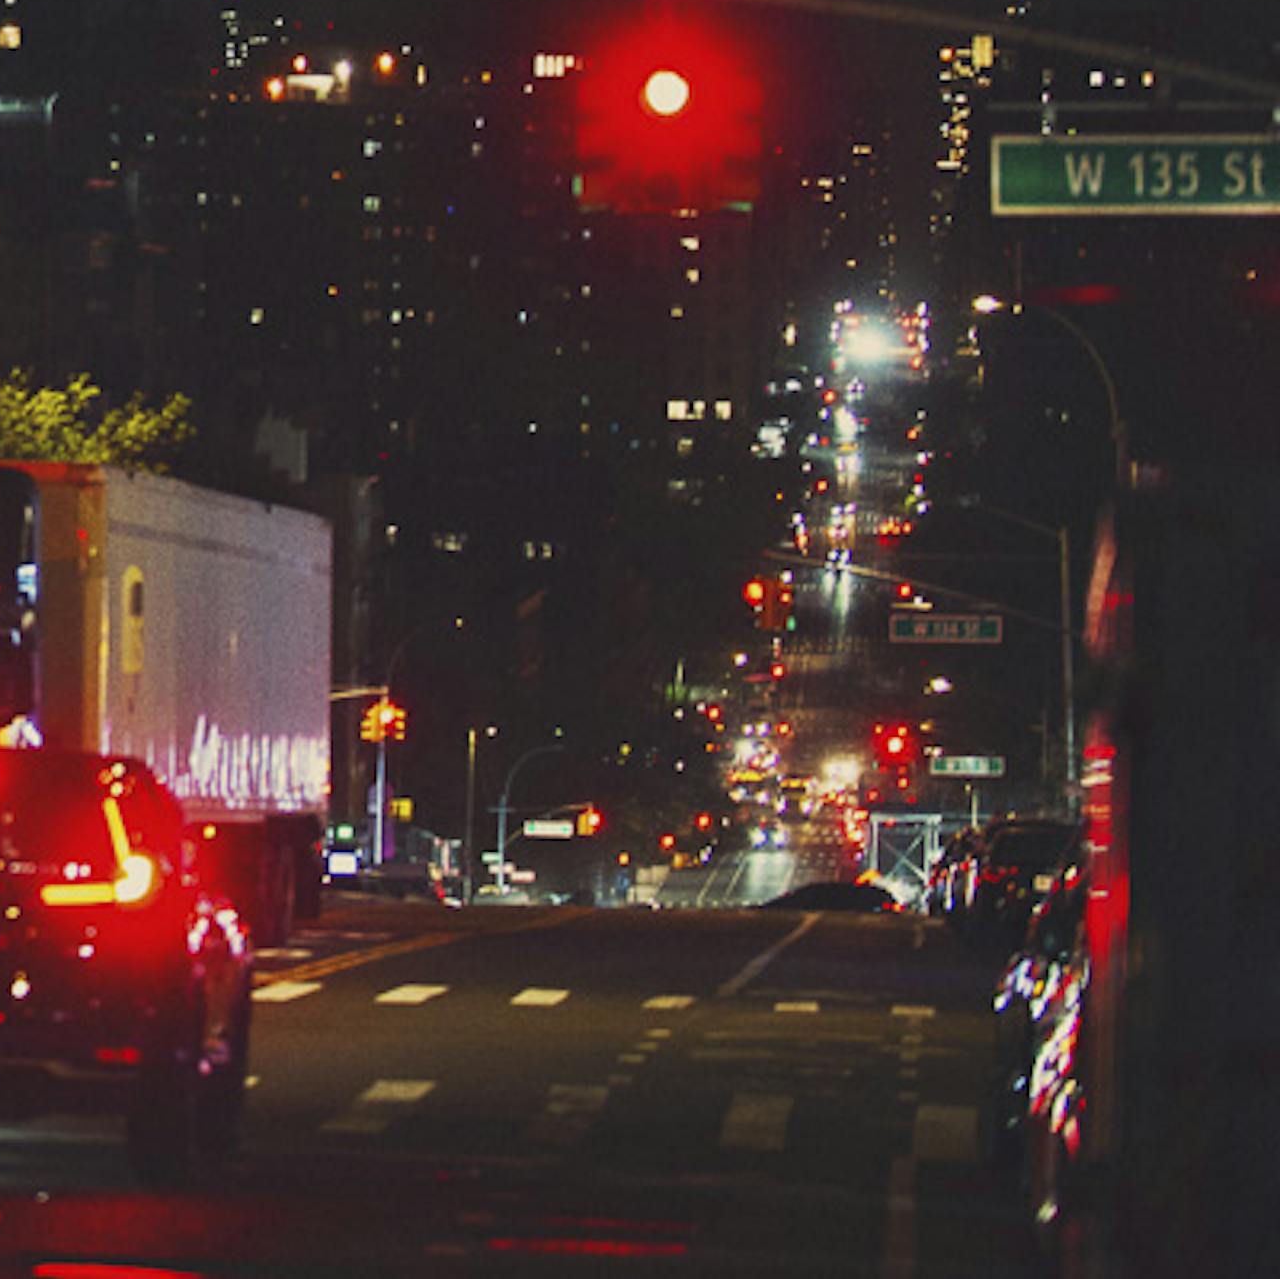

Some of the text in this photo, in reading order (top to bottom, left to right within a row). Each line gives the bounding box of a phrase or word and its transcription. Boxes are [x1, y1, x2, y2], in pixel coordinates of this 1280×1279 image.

[1064, 151, 1265, 197] W 135 St
